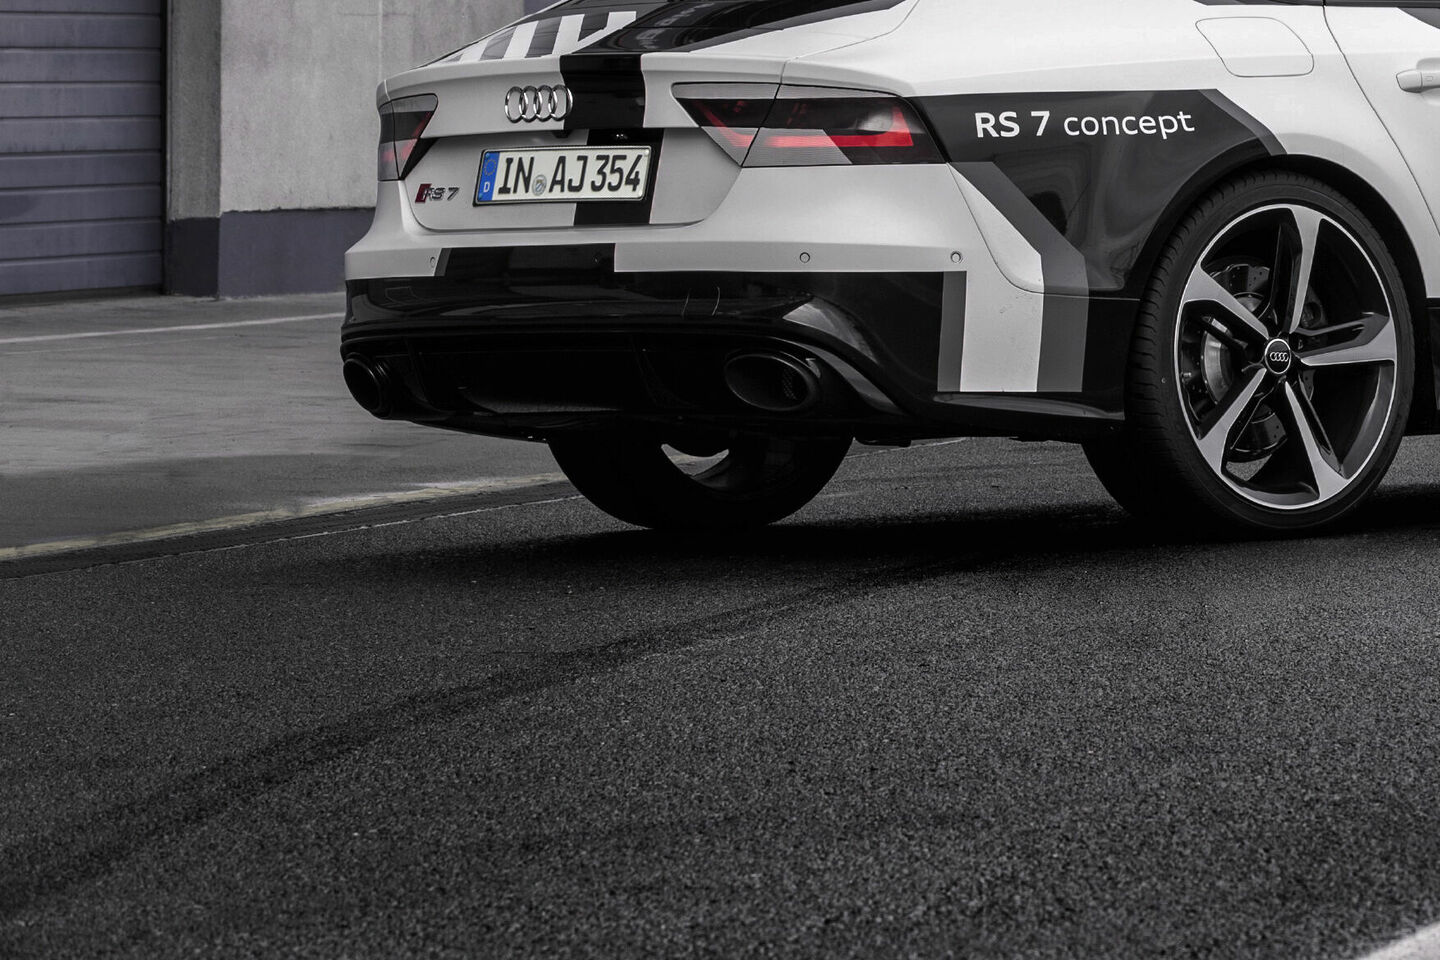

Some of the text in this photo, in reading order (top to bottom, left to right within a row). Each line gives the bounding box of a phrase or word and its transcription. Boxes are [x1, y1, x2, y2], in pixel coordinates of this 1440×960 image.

[975, 110, 1195, 139] RS 7 concept
[498, 156, 535, 194] IN
[548, 155, 588, 193] AJ
[590, 154, 643, 192] 354
